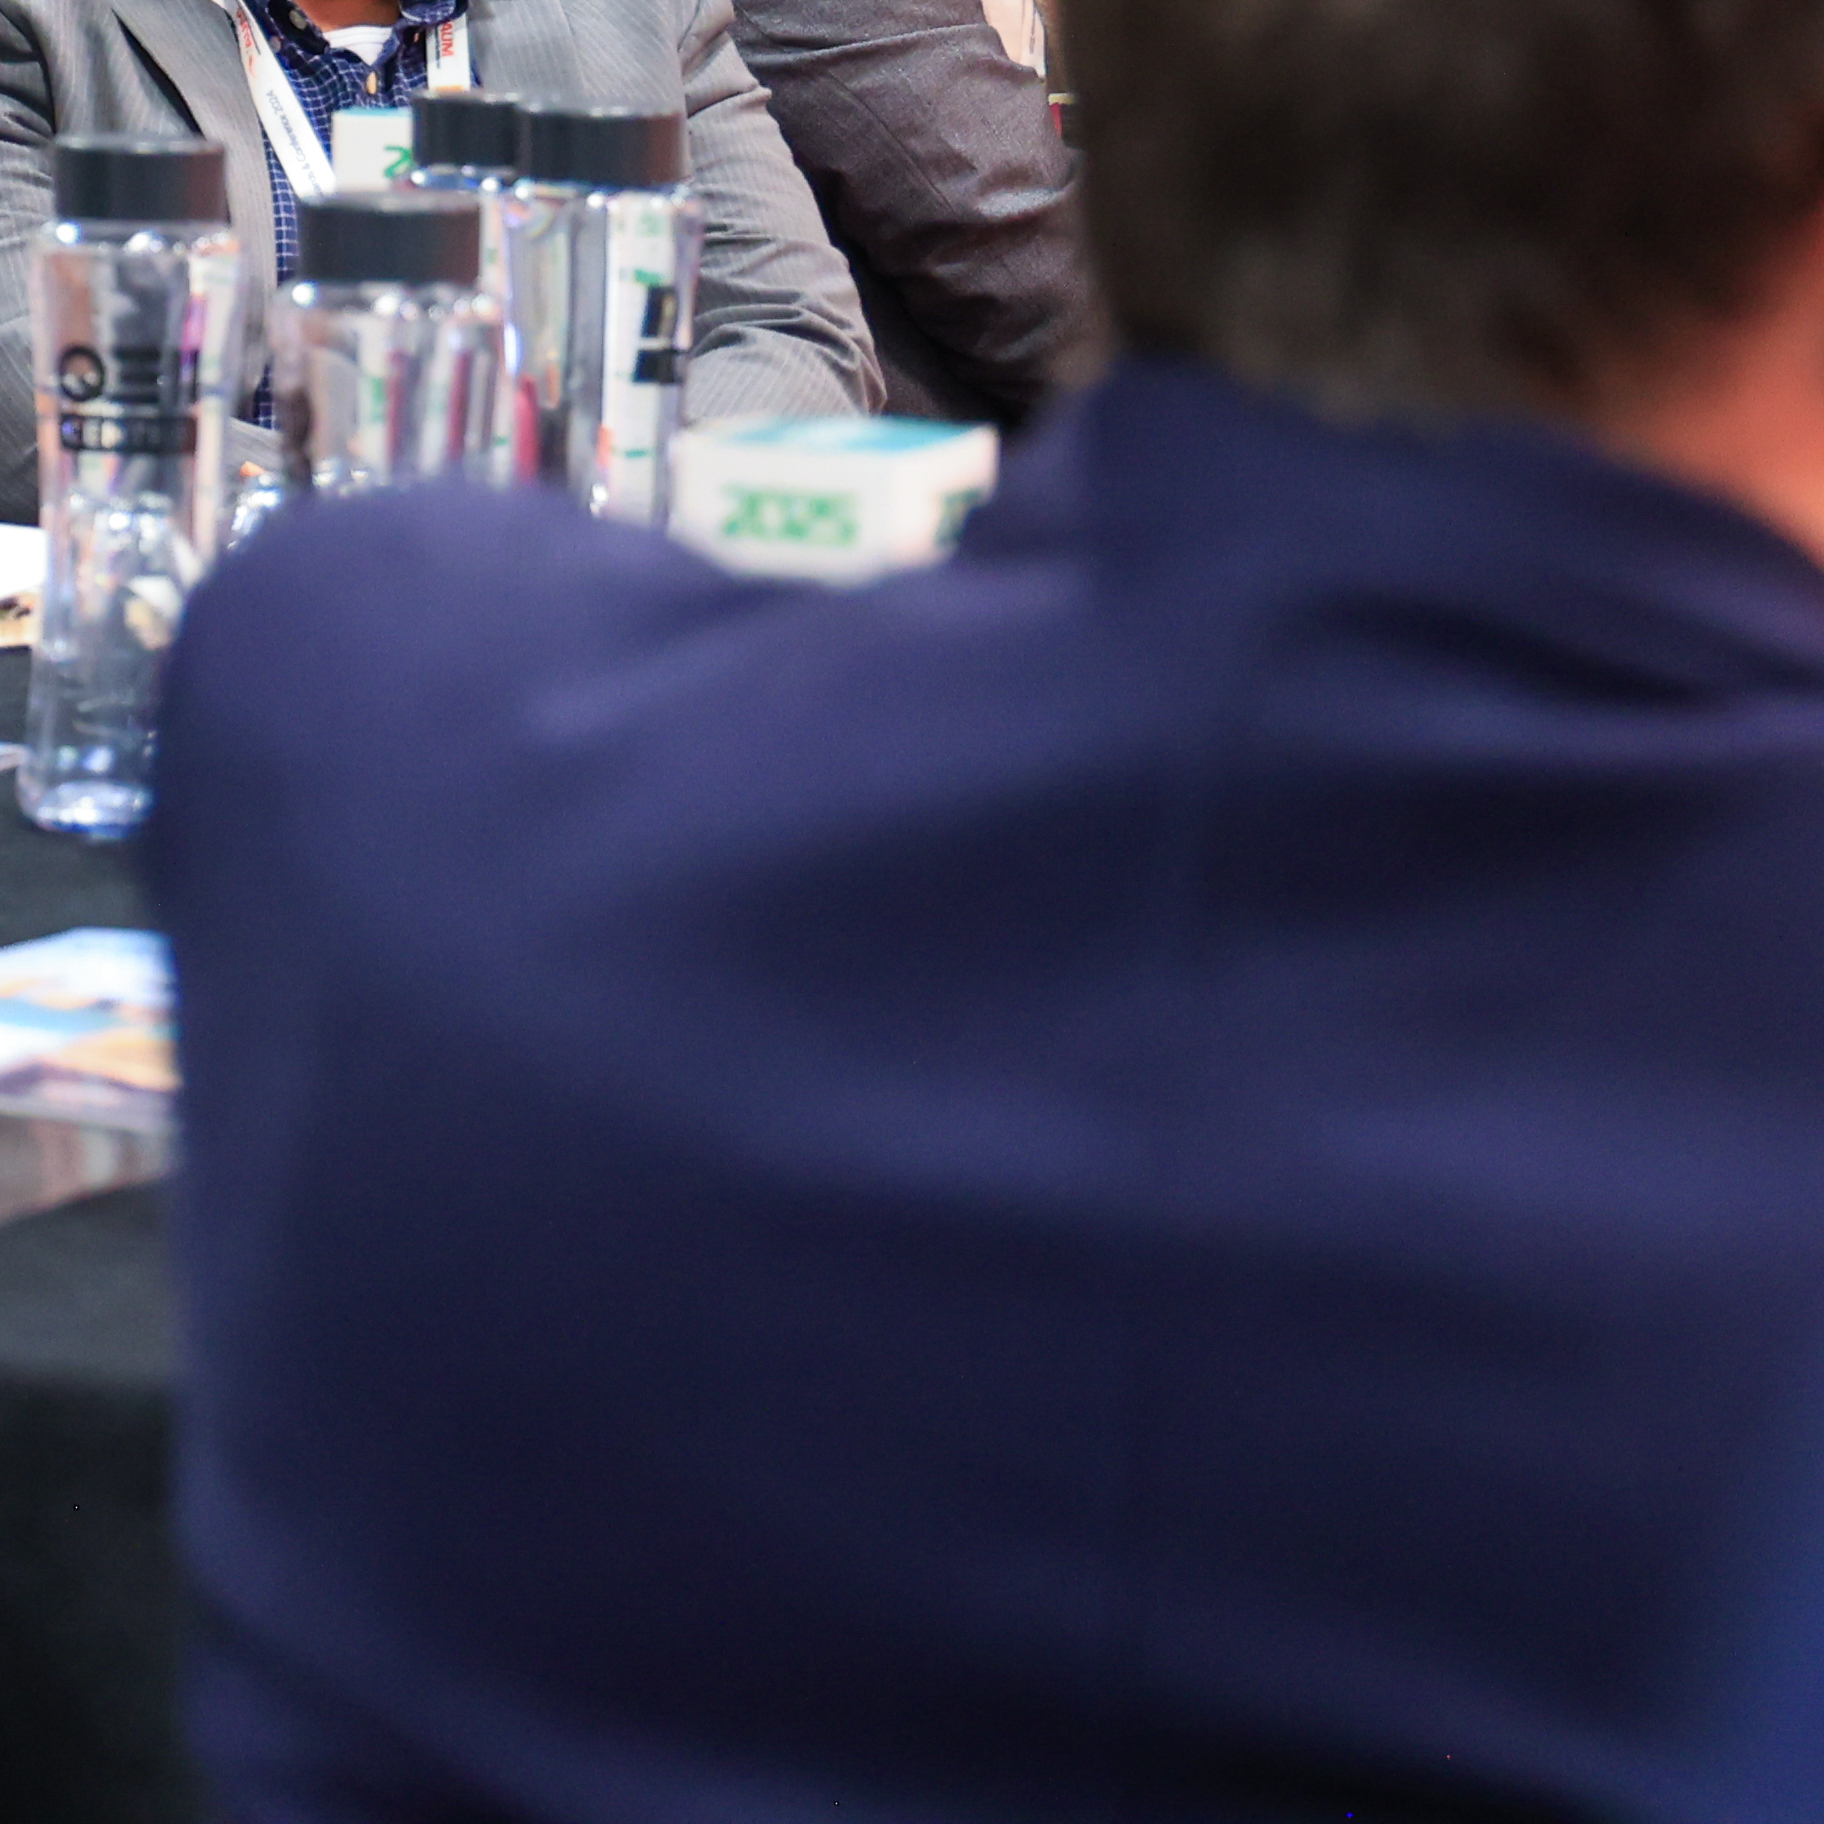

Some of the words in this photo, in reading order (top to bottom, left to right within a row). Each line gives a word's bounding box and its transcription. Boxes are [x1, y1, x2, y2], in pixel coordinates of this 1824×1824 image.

[438, 21, 456, 57] AUM
[265, 89, 282, 114] 2024
[278, 113, 306, 163] Conference
